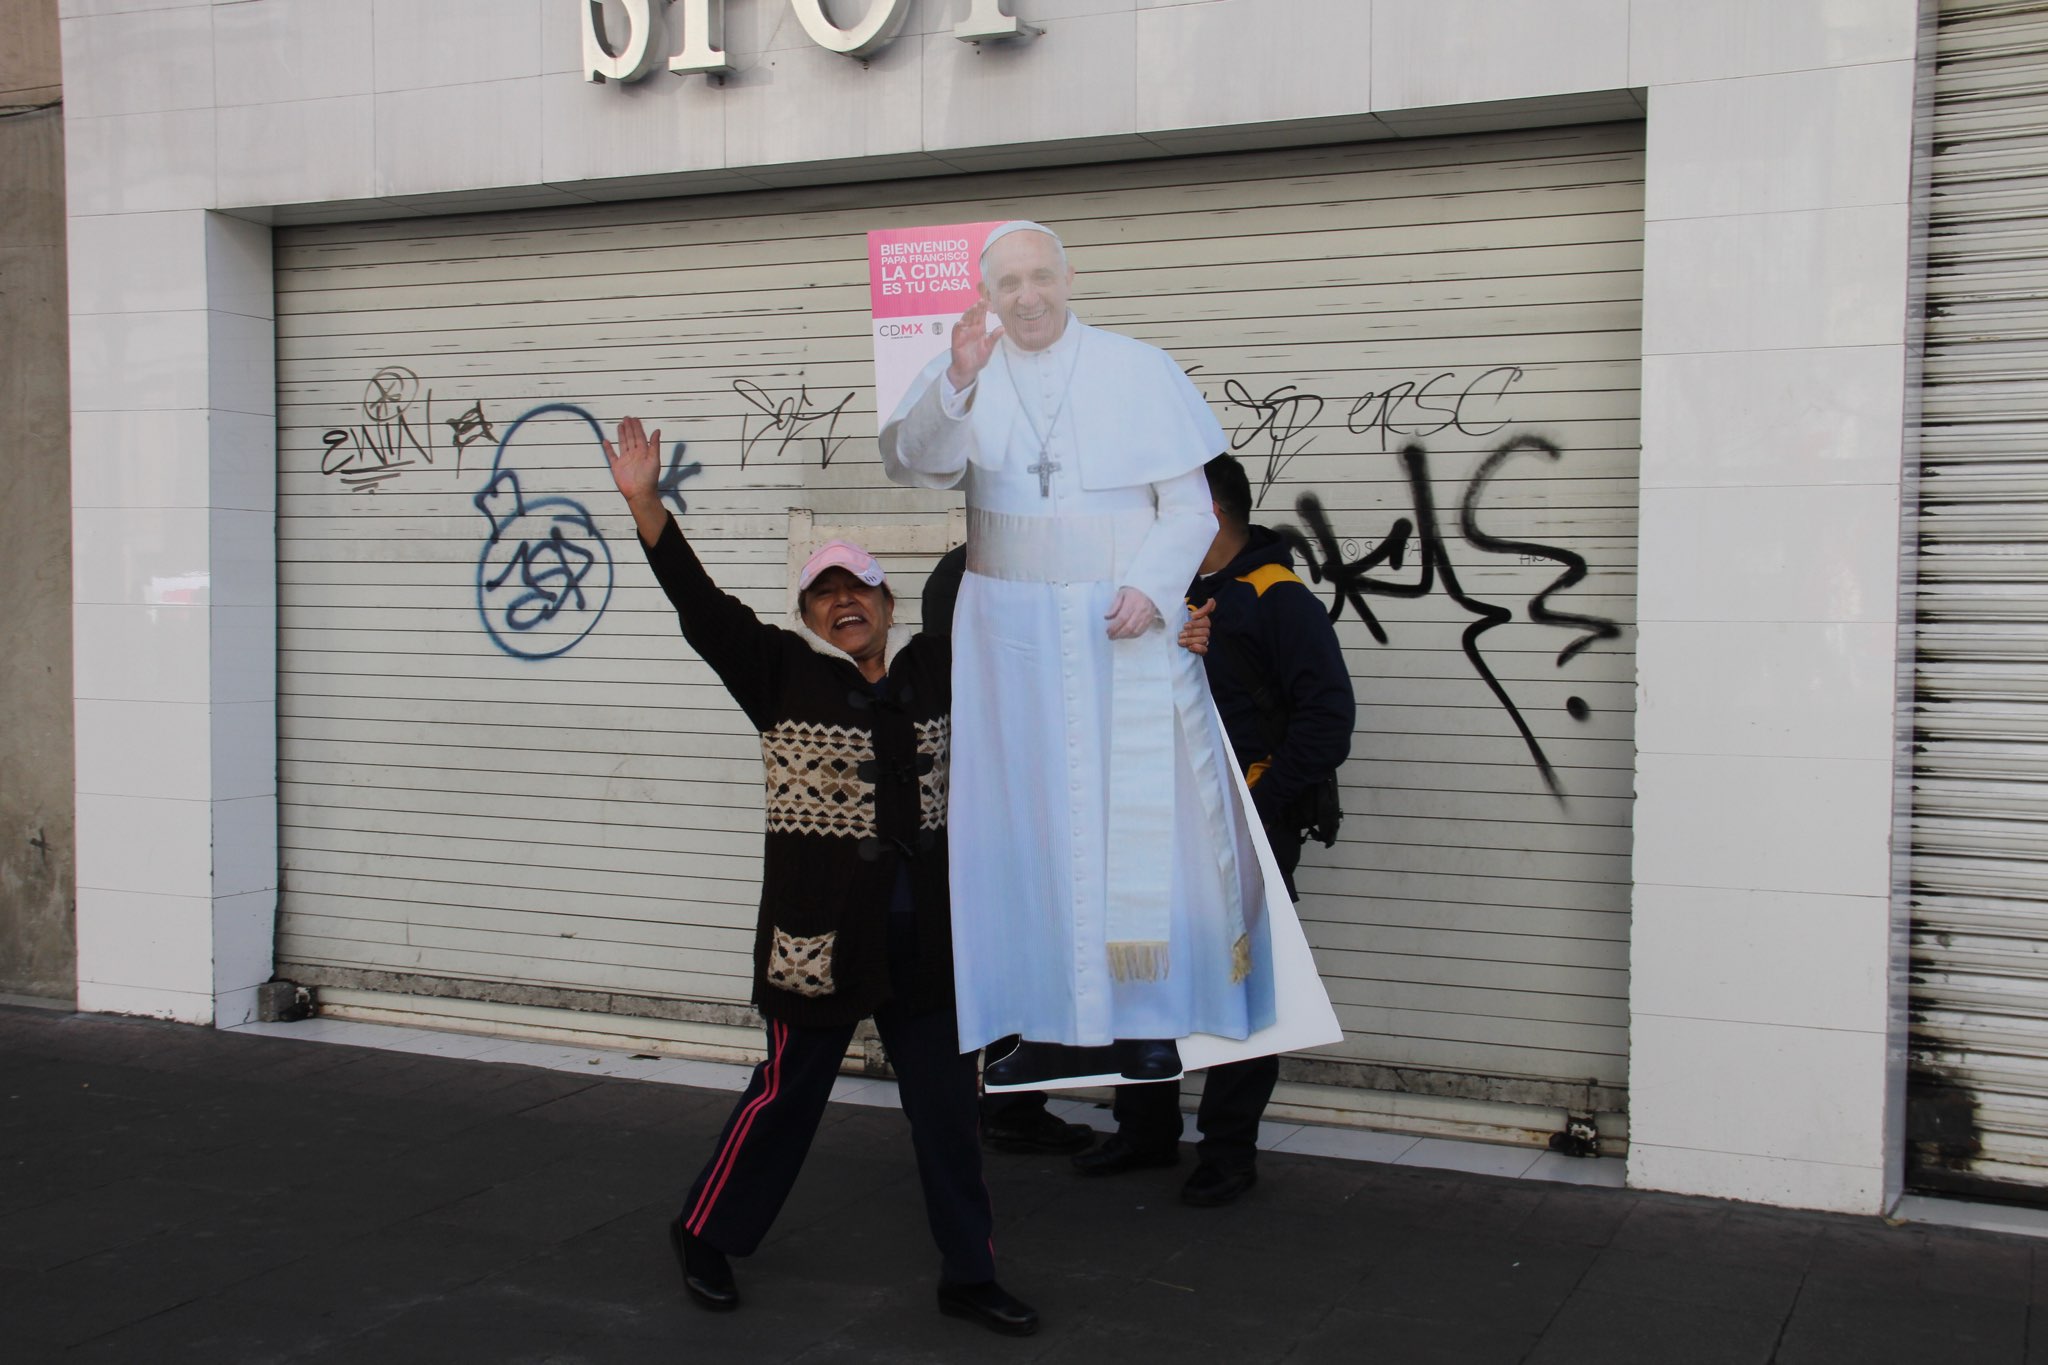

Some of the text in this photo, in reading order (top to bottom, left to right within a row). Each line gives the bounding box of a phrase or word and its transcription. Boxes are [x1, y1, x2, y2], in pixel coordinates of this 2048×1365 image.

[880, 239, 969, 256] BIENVENIDO
[881, 251, 969, 265] PAPA FRANCISCO
[881, 261, 970, 282] LA CDMX
[882, 278, 971, 295] ES TU CASA
[879, 323, 924, 337] CDMX
